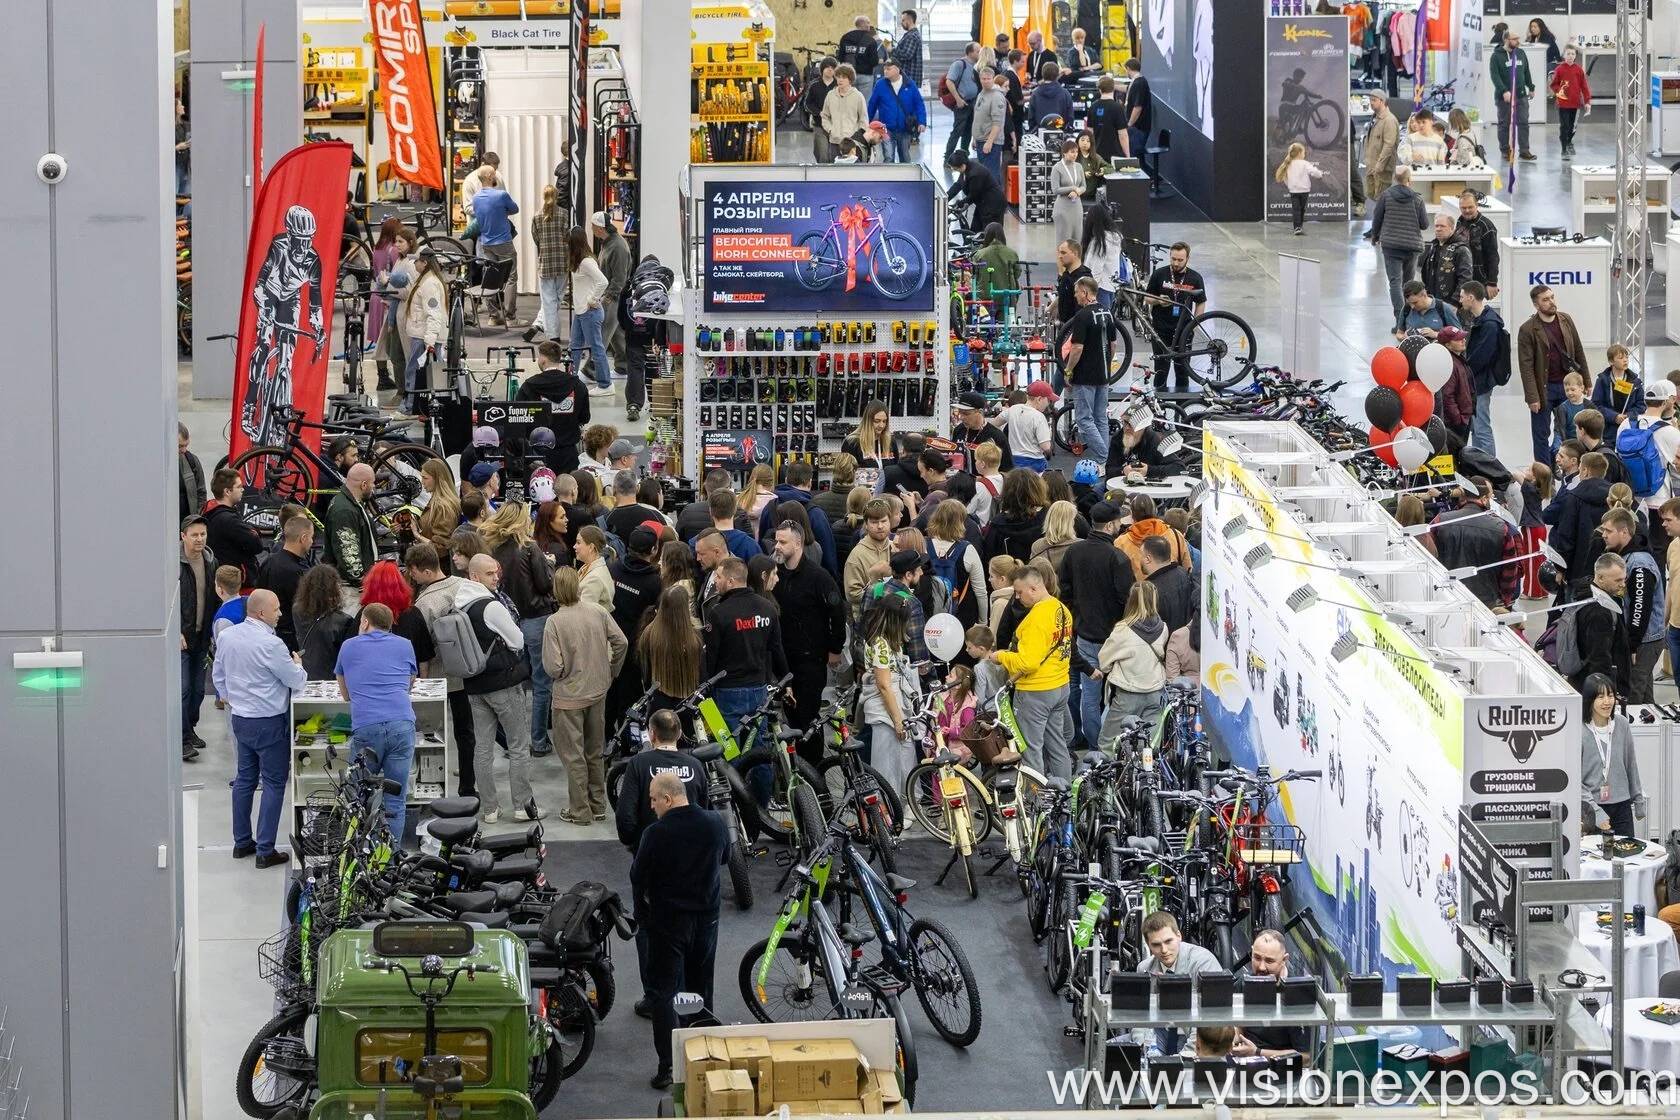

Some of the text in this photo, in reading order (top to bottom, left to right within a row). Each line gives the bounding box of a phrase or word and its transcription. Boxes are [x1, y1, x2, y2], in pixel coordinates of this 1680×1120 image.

[400, 0, 421, 55] SP
[491, 29, 561, 38] Black Cat Tire
[713, 192, 795, 204] 4 АПРЕЛЯ
[713, 207, 811, 219] РОЗЫГРЫШ
[715, 237, 788, 247] ВЕЛОСИПЕД
[752, 249, 806, 259] CONNECT
[746, 270, 784, 278] СКЕЙТБОРД
[1529, 271, 1592, 285] KENLI
[713, 291, 765, 302] bikecenter
[508, 406, 528, 416] funny
[508, 414, 534, 423] animals
[1632, 567, 1645, 627] МОТОМОСКВА
[1374, 628, 1446, 720] ЭЛЕКТРОВЕЛОСИПЕДЫ
[1484, 772, 1535, 781] ГРУЗОВЫЕ
[1484, 783, 1536, 792] ТРИЦИКЛЫ
[1484, 803, 1550, 813] ПАССАЖИРСК
[1529, 871, 1552, 879] ЬНАЯ
